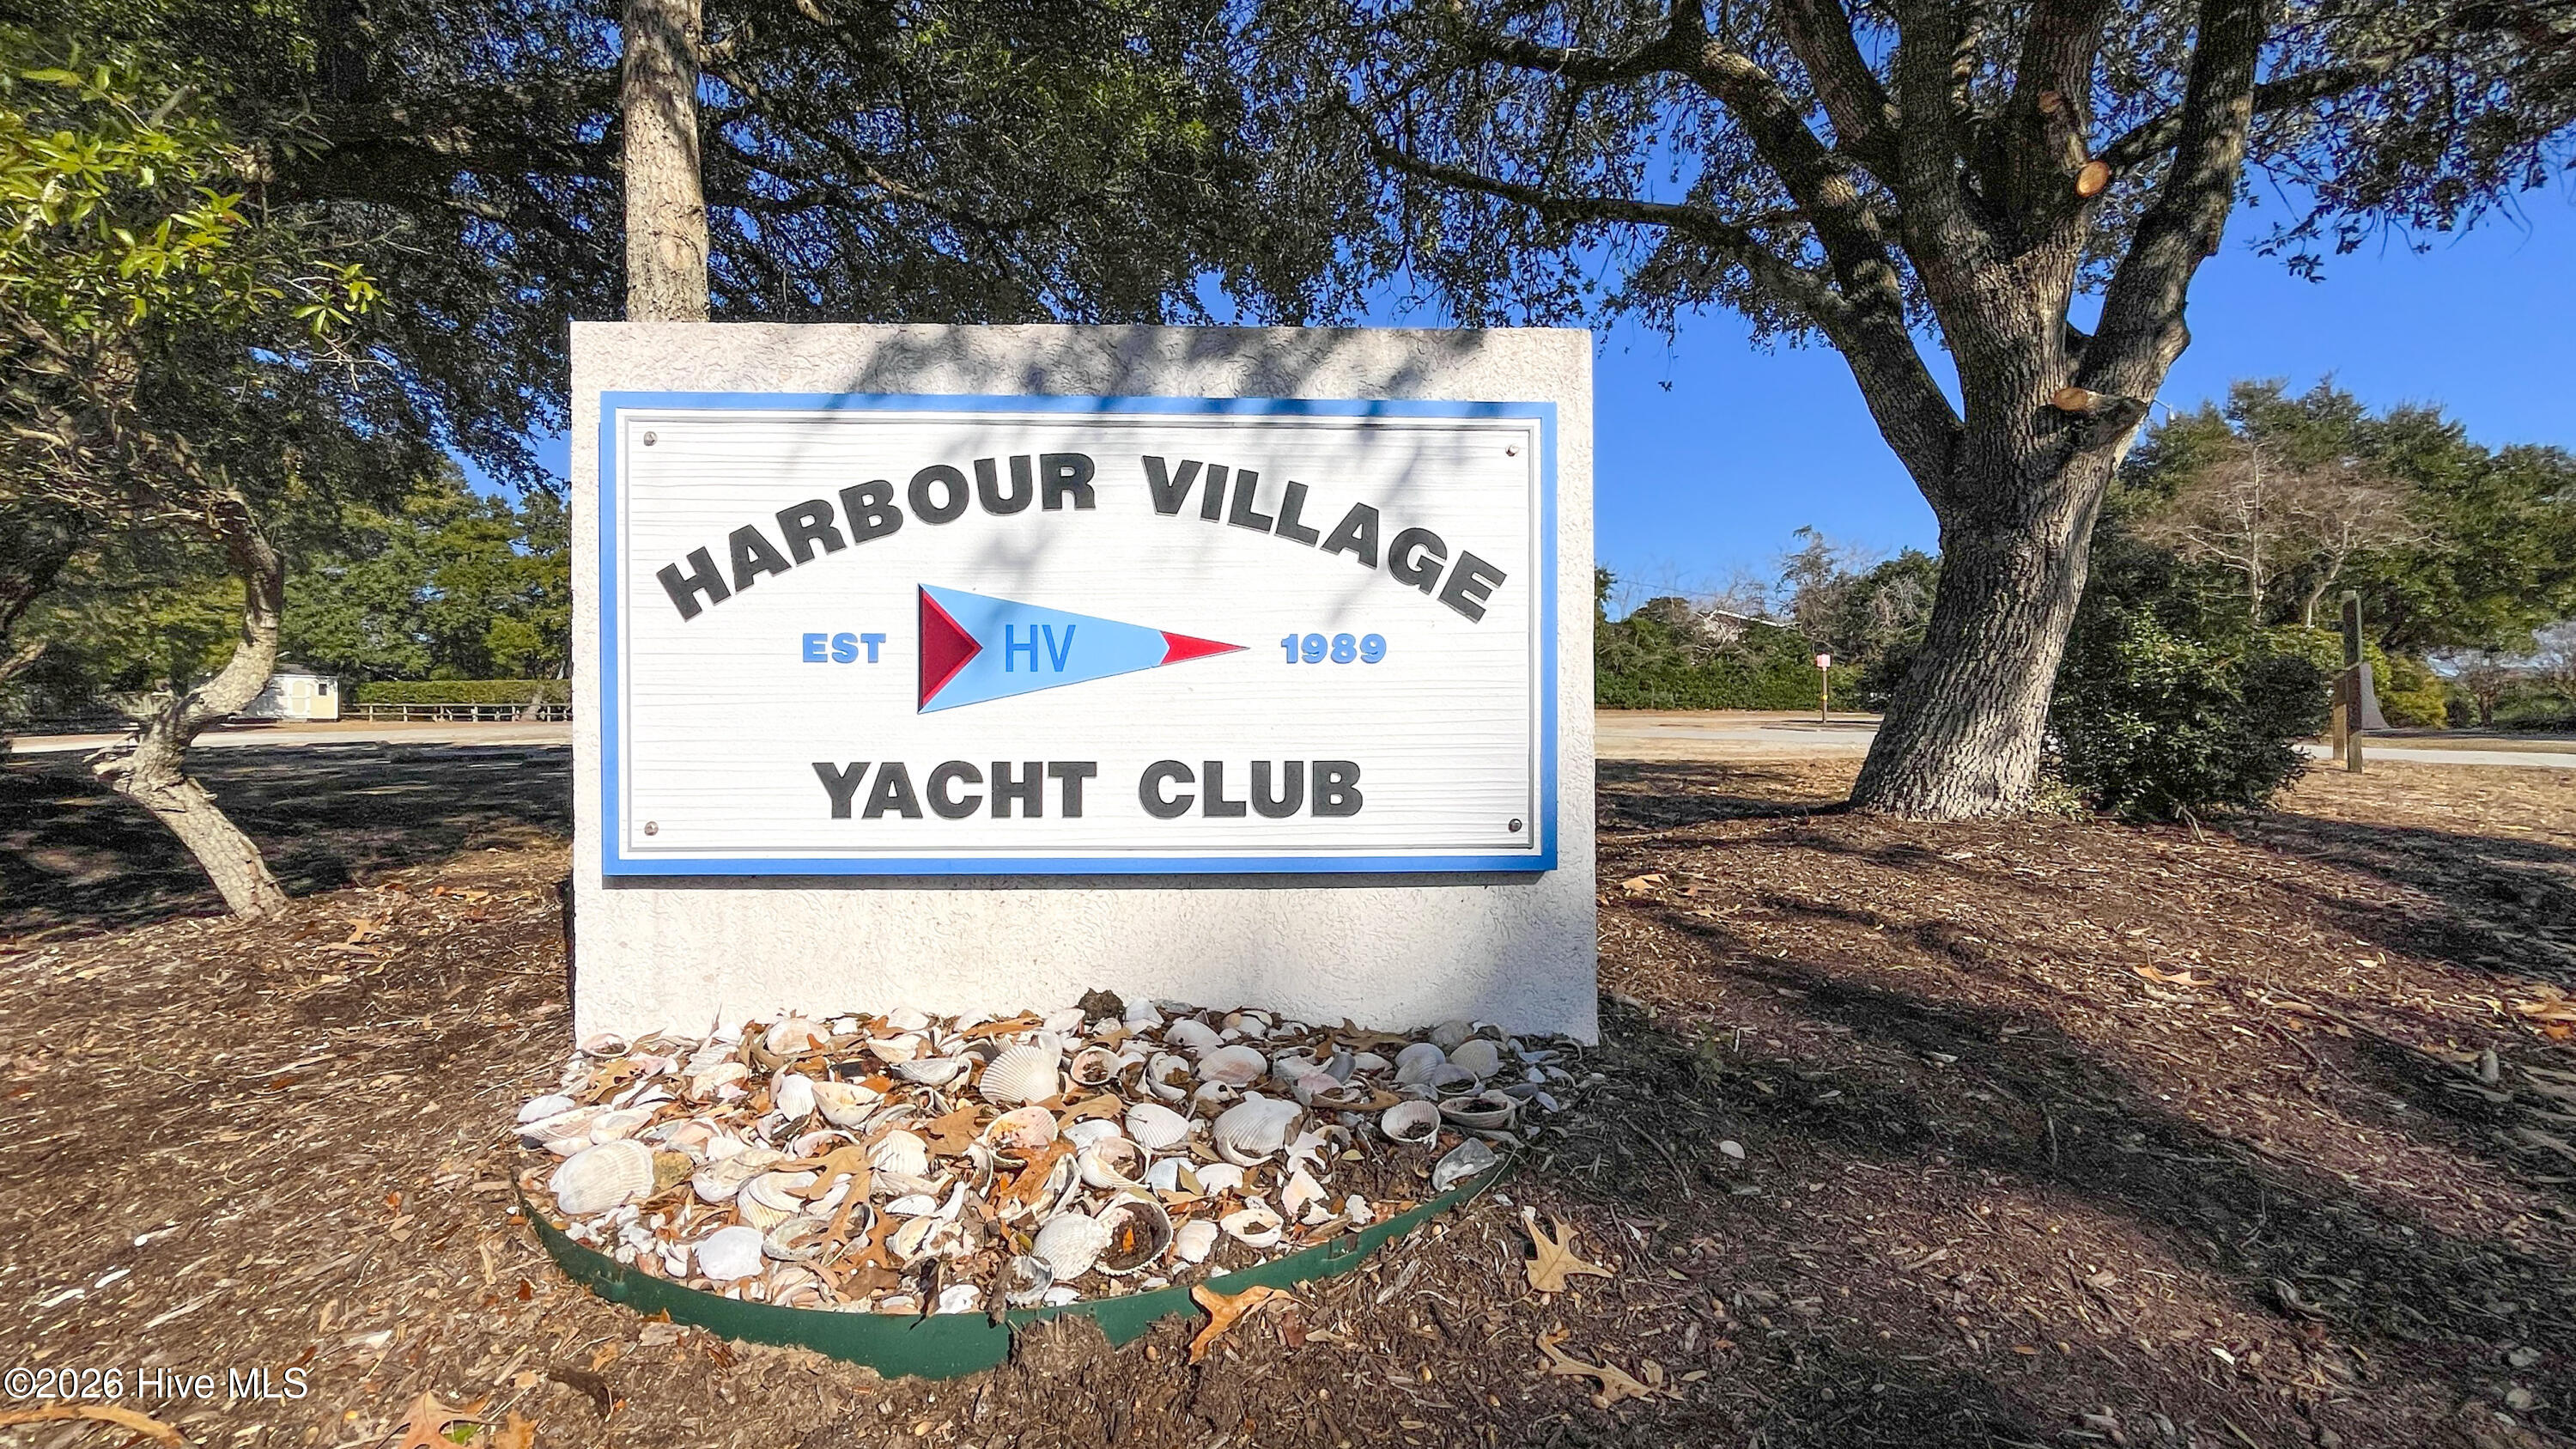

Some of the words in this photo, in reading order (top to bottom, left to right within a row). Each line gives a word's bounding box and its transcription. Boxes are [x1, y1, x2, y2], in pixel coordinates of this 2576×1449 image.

[655, 453, 1096, 621] HARBOUR
[1140, 454, 1508, 624] VILLAGE
[802, 632, 887, 664] EST
[1005, 624, 1077, 673] HV
[1280, 633, 1388, 665] 1989
[812, 761, 1097, 819] YACHT
[1139, 759, 1364, 819] CLUB
